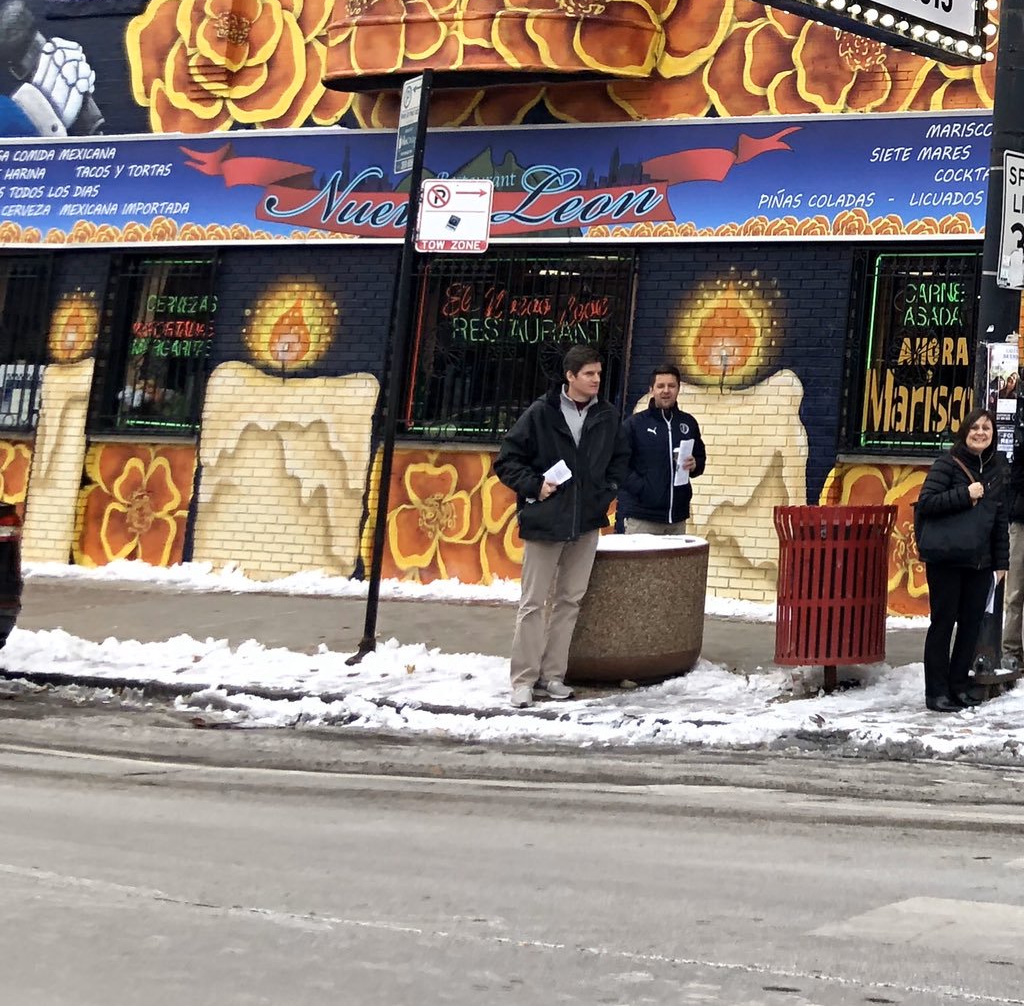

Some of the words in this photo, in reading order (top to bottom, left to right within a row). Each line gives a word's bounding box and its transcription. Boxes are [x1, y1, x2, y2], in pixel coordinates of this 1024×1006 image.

[926, 122, 993, 139] MARISCO
[13, 149, 55, 162] COMIDA
[58, 147, 117, 161] MEXICANA
[870, 147, 913, 163] SIETE
[917, 145, 972, 161] MARES
[4, 167, 46, 180] HARINA
[75, 165, 111, 178] TACOS
[114, 165, 124, 178] Y
[128, 163, 173, 177] TORTAS
[10, 185, 45, 199] TODOS
[47, 185, 70, 198] LOS
[73, 184, 101, 198] DIAS
[265, 165, 409, 228] Nuev
[491, 164, 664, 224] Leon
[757, 188, 803, 209] PIÑAS
[807, 192, 876, 208] COLADAS
[909, 190, 984, 206] LICUADOS
[1, 203, 52, 217] CERVEZA
[59, 202, 119, 216] MEXICANA
[122, 202, 190, 215] IMPORTADA
[421, 240, 446, 250] TOW
[449, 240, 481, 250] ZONE
[905, 282, 966, 304] CARNE
[903, 306, 963, 326] ASADA
[452, 317, 606, 344] RESTAURANT
[897, 337, 969, 366] AHORA
